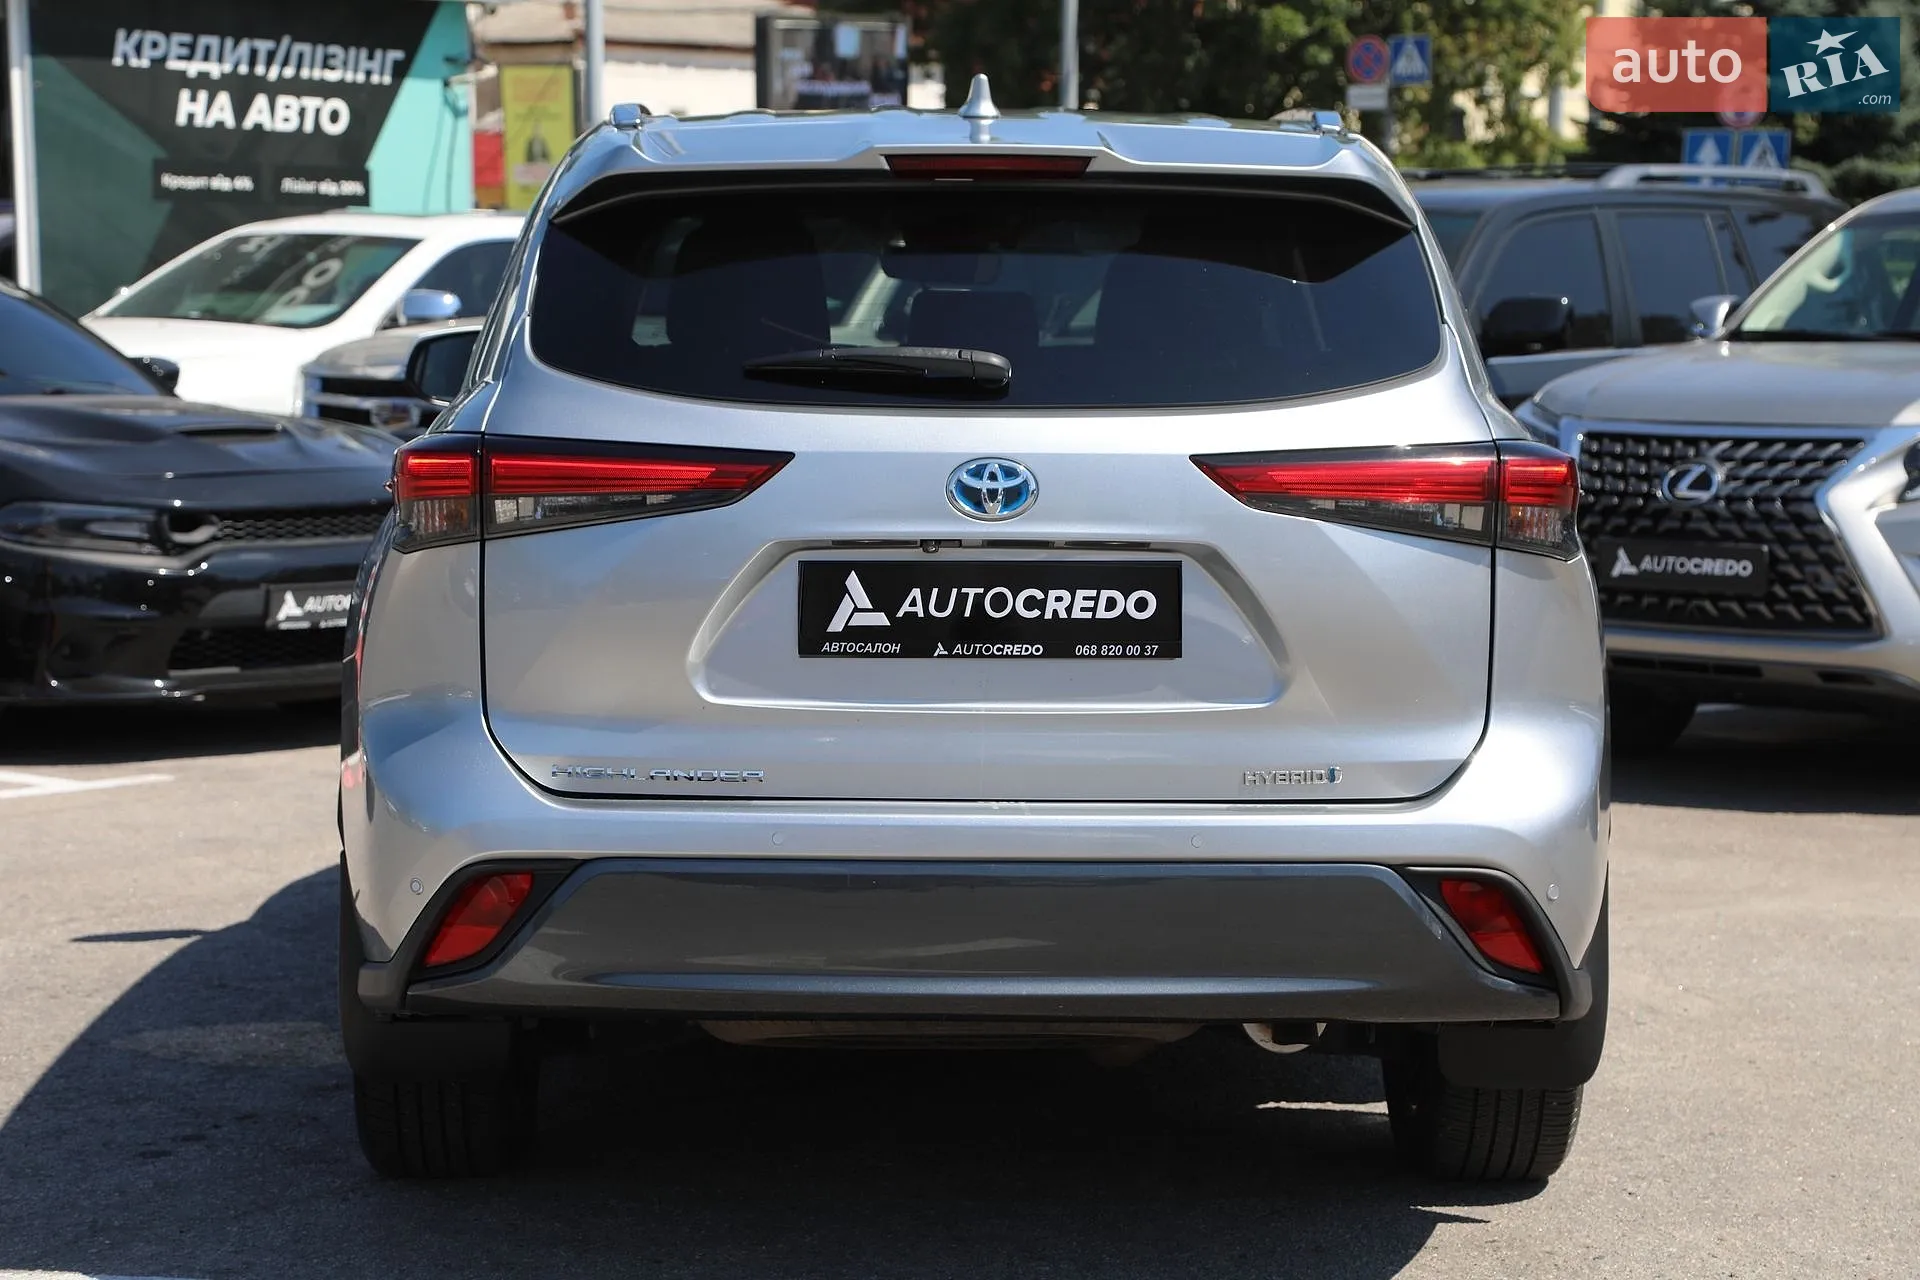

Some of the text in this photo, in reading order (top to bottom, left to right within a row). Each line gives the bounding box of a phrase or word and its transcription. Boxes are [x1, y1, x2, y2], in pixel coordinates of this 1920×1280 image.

[112, 28, 405, 85] КРЕДИТ/ЛІЗІНГ
[175, 88, 351, 136] НА АВТО
[1639, 554, 1753, 578] AUTOCREDO
[895, 586, 1157, 620] AUTOCREDO
[821, 642, 901, 654] АВТОСАЛОН
[952, 643, 1044, 656] AUTOCREDO
[1075, 644, 1159, 656] 068 820 00 37
[551, 764, 764, 782] HIGHLANDER
[1243, 769, 1328, 785] HYBRID
